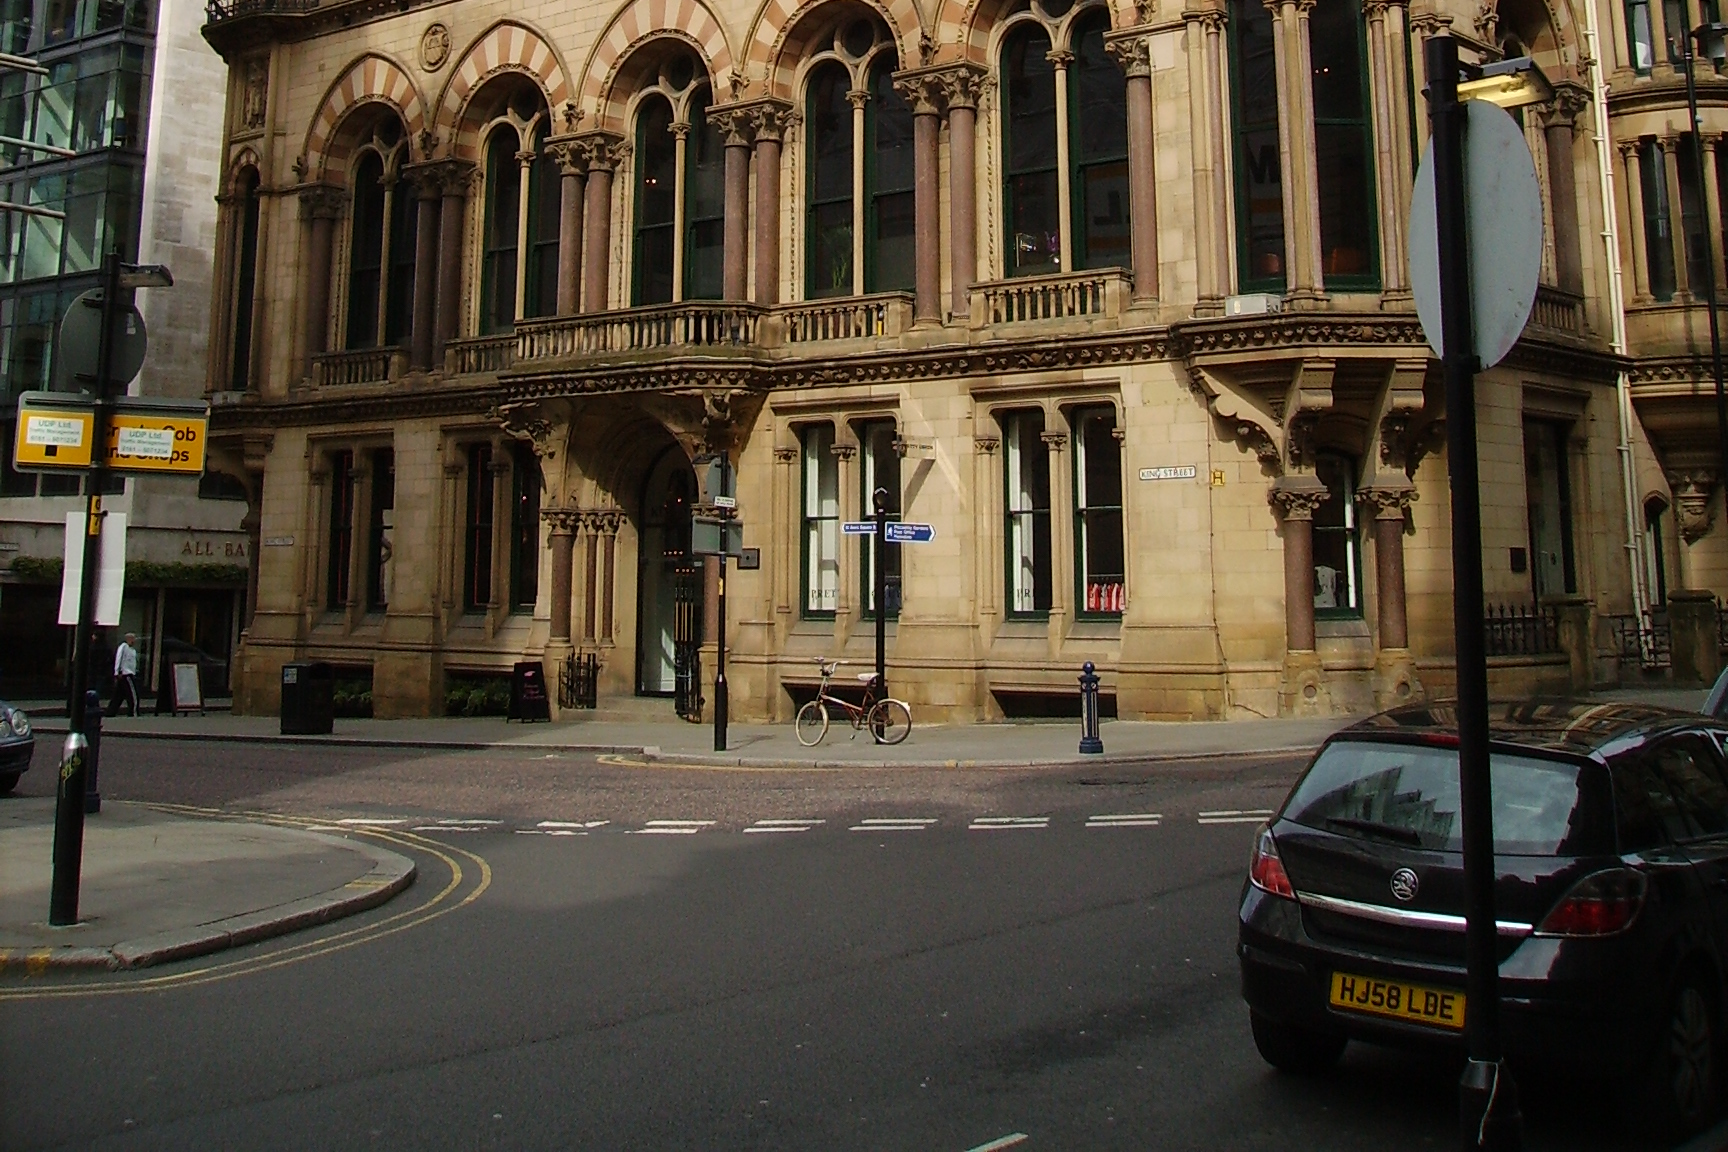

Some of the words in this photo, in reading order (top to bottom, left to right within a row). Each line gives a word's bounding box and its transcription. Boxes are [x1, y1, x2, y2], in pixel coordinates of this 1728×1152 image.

[1141, 470, 1160, 479] KING
[1163, 467, 1194, 478] STREET
[1212, 470, 1224, 484] H
[181, 541, 213, 556] ALL
[1340, 976, 1401, 1009] HJ58
[1407, 988, 1455, 1020] LDE
